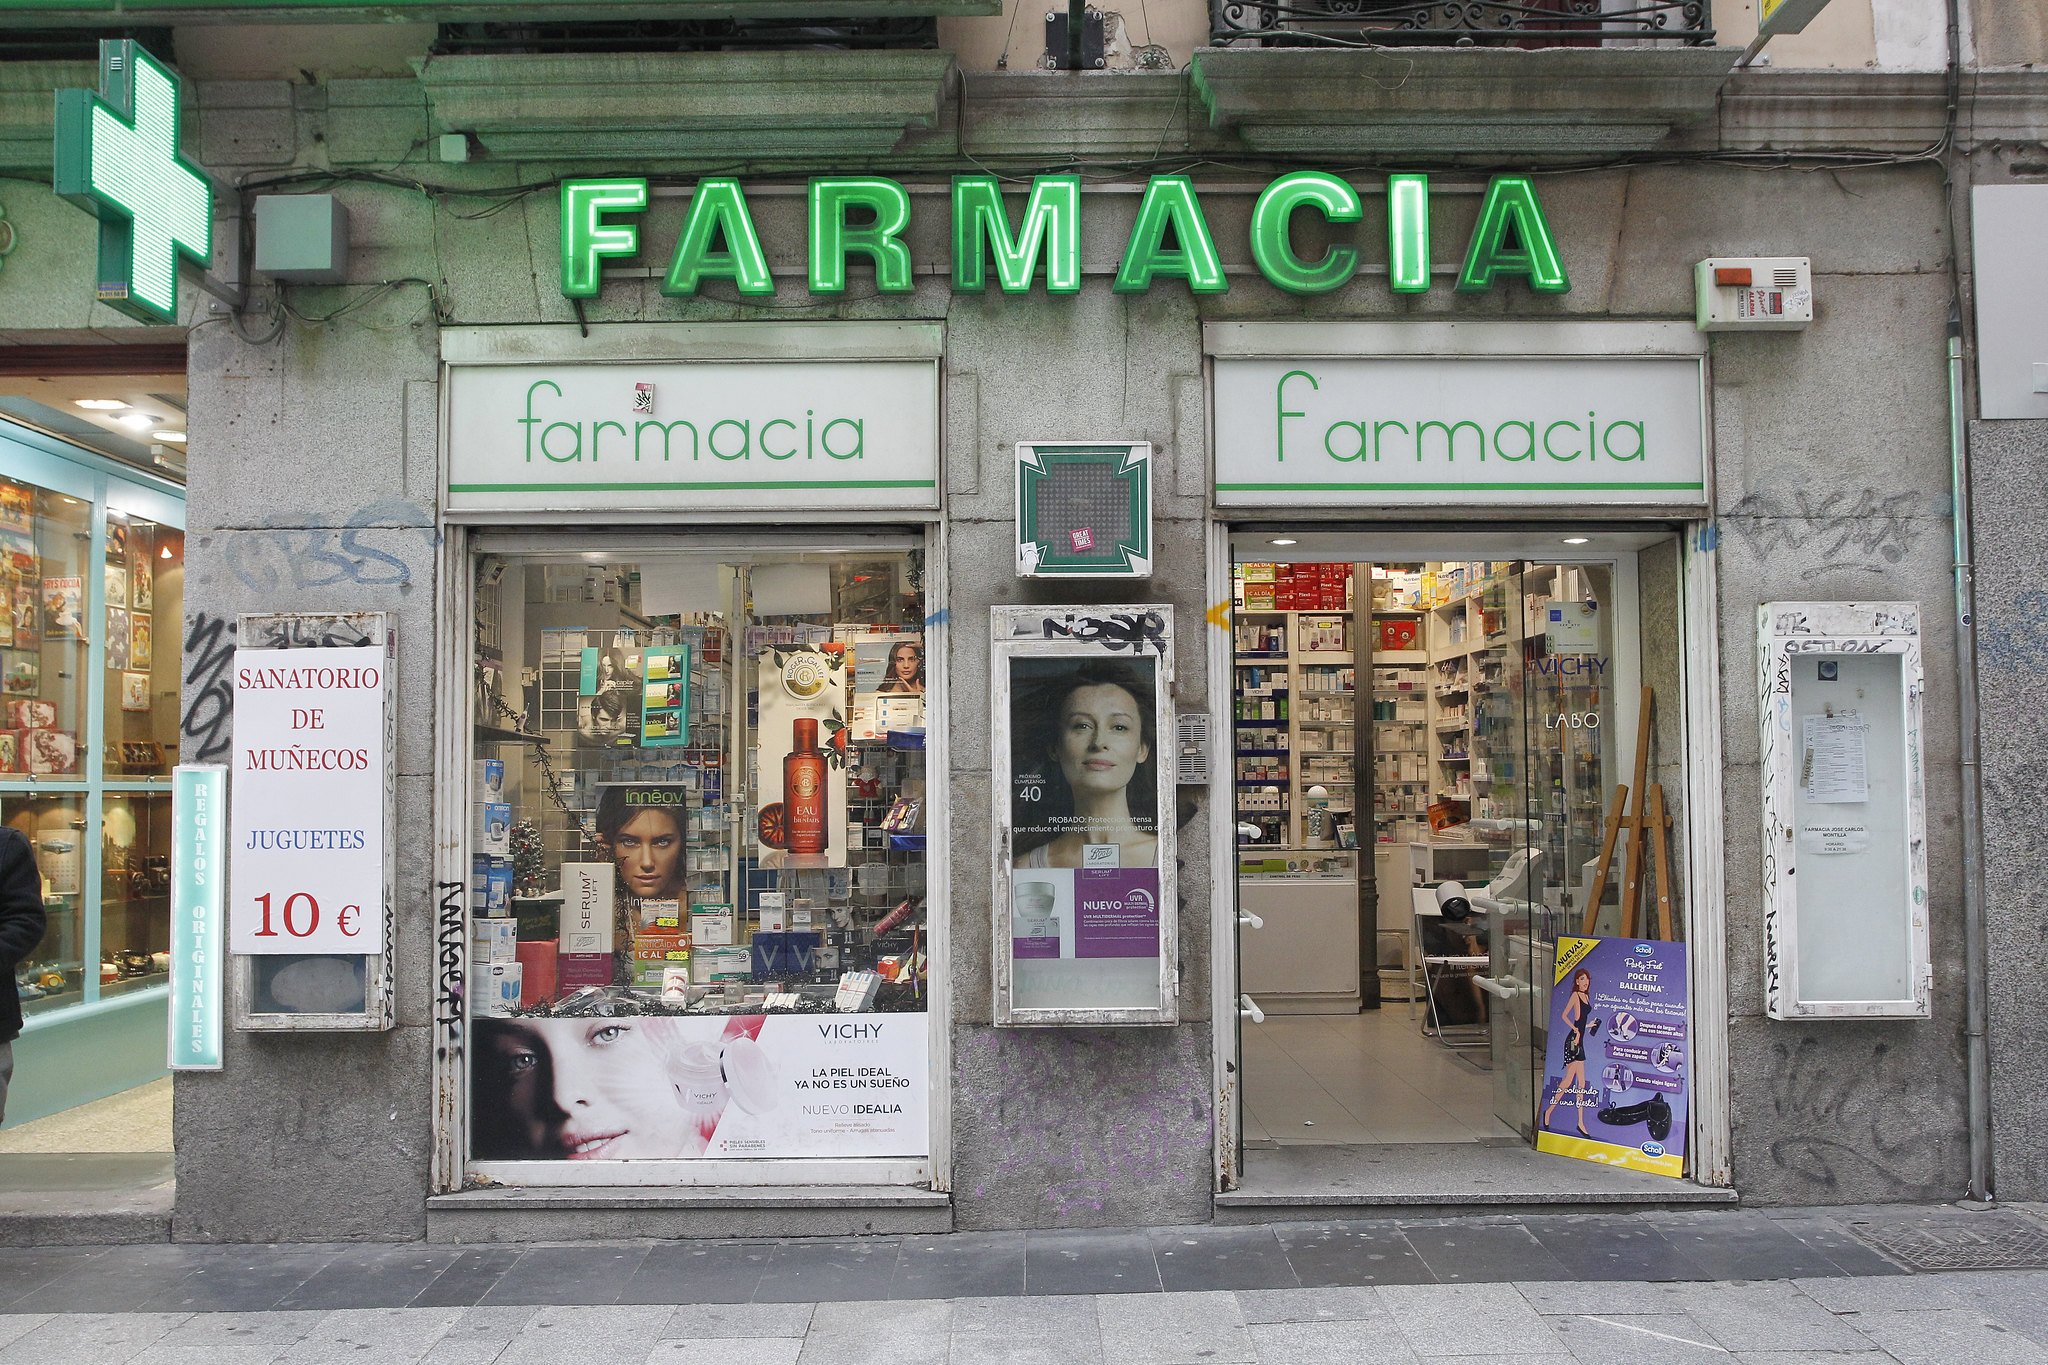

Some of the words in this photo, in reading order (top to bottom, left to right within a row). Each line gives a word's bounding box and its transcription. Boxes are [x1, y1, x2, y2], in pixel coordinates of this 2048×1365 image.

[560, 171, 1572, 298] FARMACIA
[518, 380, 863, 462] farmacia
[1277, 370, 1645, 462] farmacia
[1072, 529, 1089, 539] GREAT
[1074, 537, 1091, 547] TIMES
[1536, 657, 1608, 675] VICHY
[238, 667, 379, 690] SANATORIO
[291, 709, 324, 730] DE
[1545, 712, 1600, 729] LABO
[246, 744, 369, 770] MUÑECOS
[1020, 786, 1041, 802] 40
[796, 806, 818, 815] EAU
[194, 783, 208, 886] REGALOS
[1061, 825, 1114, 834] envejecimiento
[246, 830, 364, 850] JUGUETES
[1084, 901, 1122, 910] NUEVO
[254, 892, 320, 937] 10
[337, 905, 360, 937] €
[1557, 940, 1583, 967] NUEVAS
[1635, 946, 1651, 954] Scholl
[759, 945, 778, 971] V
[793, 945, 814, 971] V
[1624, 957, 1647, 972] Party
[191, 905, 207, 1053] ORIGINALES
[1628, 973, 1658, 982] POCKET
[818, 1023, 883, 1038] VICHY
[812, 1068, 827, 1077] LA
[830, 1068, 854, 1077] PIEL
[858, 1067, 891, 1076] IDEAL
[794, 1080, 809, 1089] YA
[812, 1080, 830, 1089] NO
[833, 1080, 847, 1088] ES
[850, 1079, 866, 1088] UN
[870, 1076, 910, 1088] SUEÑO
[1564, 1084, 1598, 1095] volviendo
[1651, 1078, 1663, 1086] viajes
[802, 1105, 849, 1115] NUEVO
[853, 1104, 902, 1114] IDEALIA
[1549, 1096, 1559, 1105] de
[1575, 1098, 1599, 1109] fiesta!
[1643, 1144, 1662, 1154] Scholl
